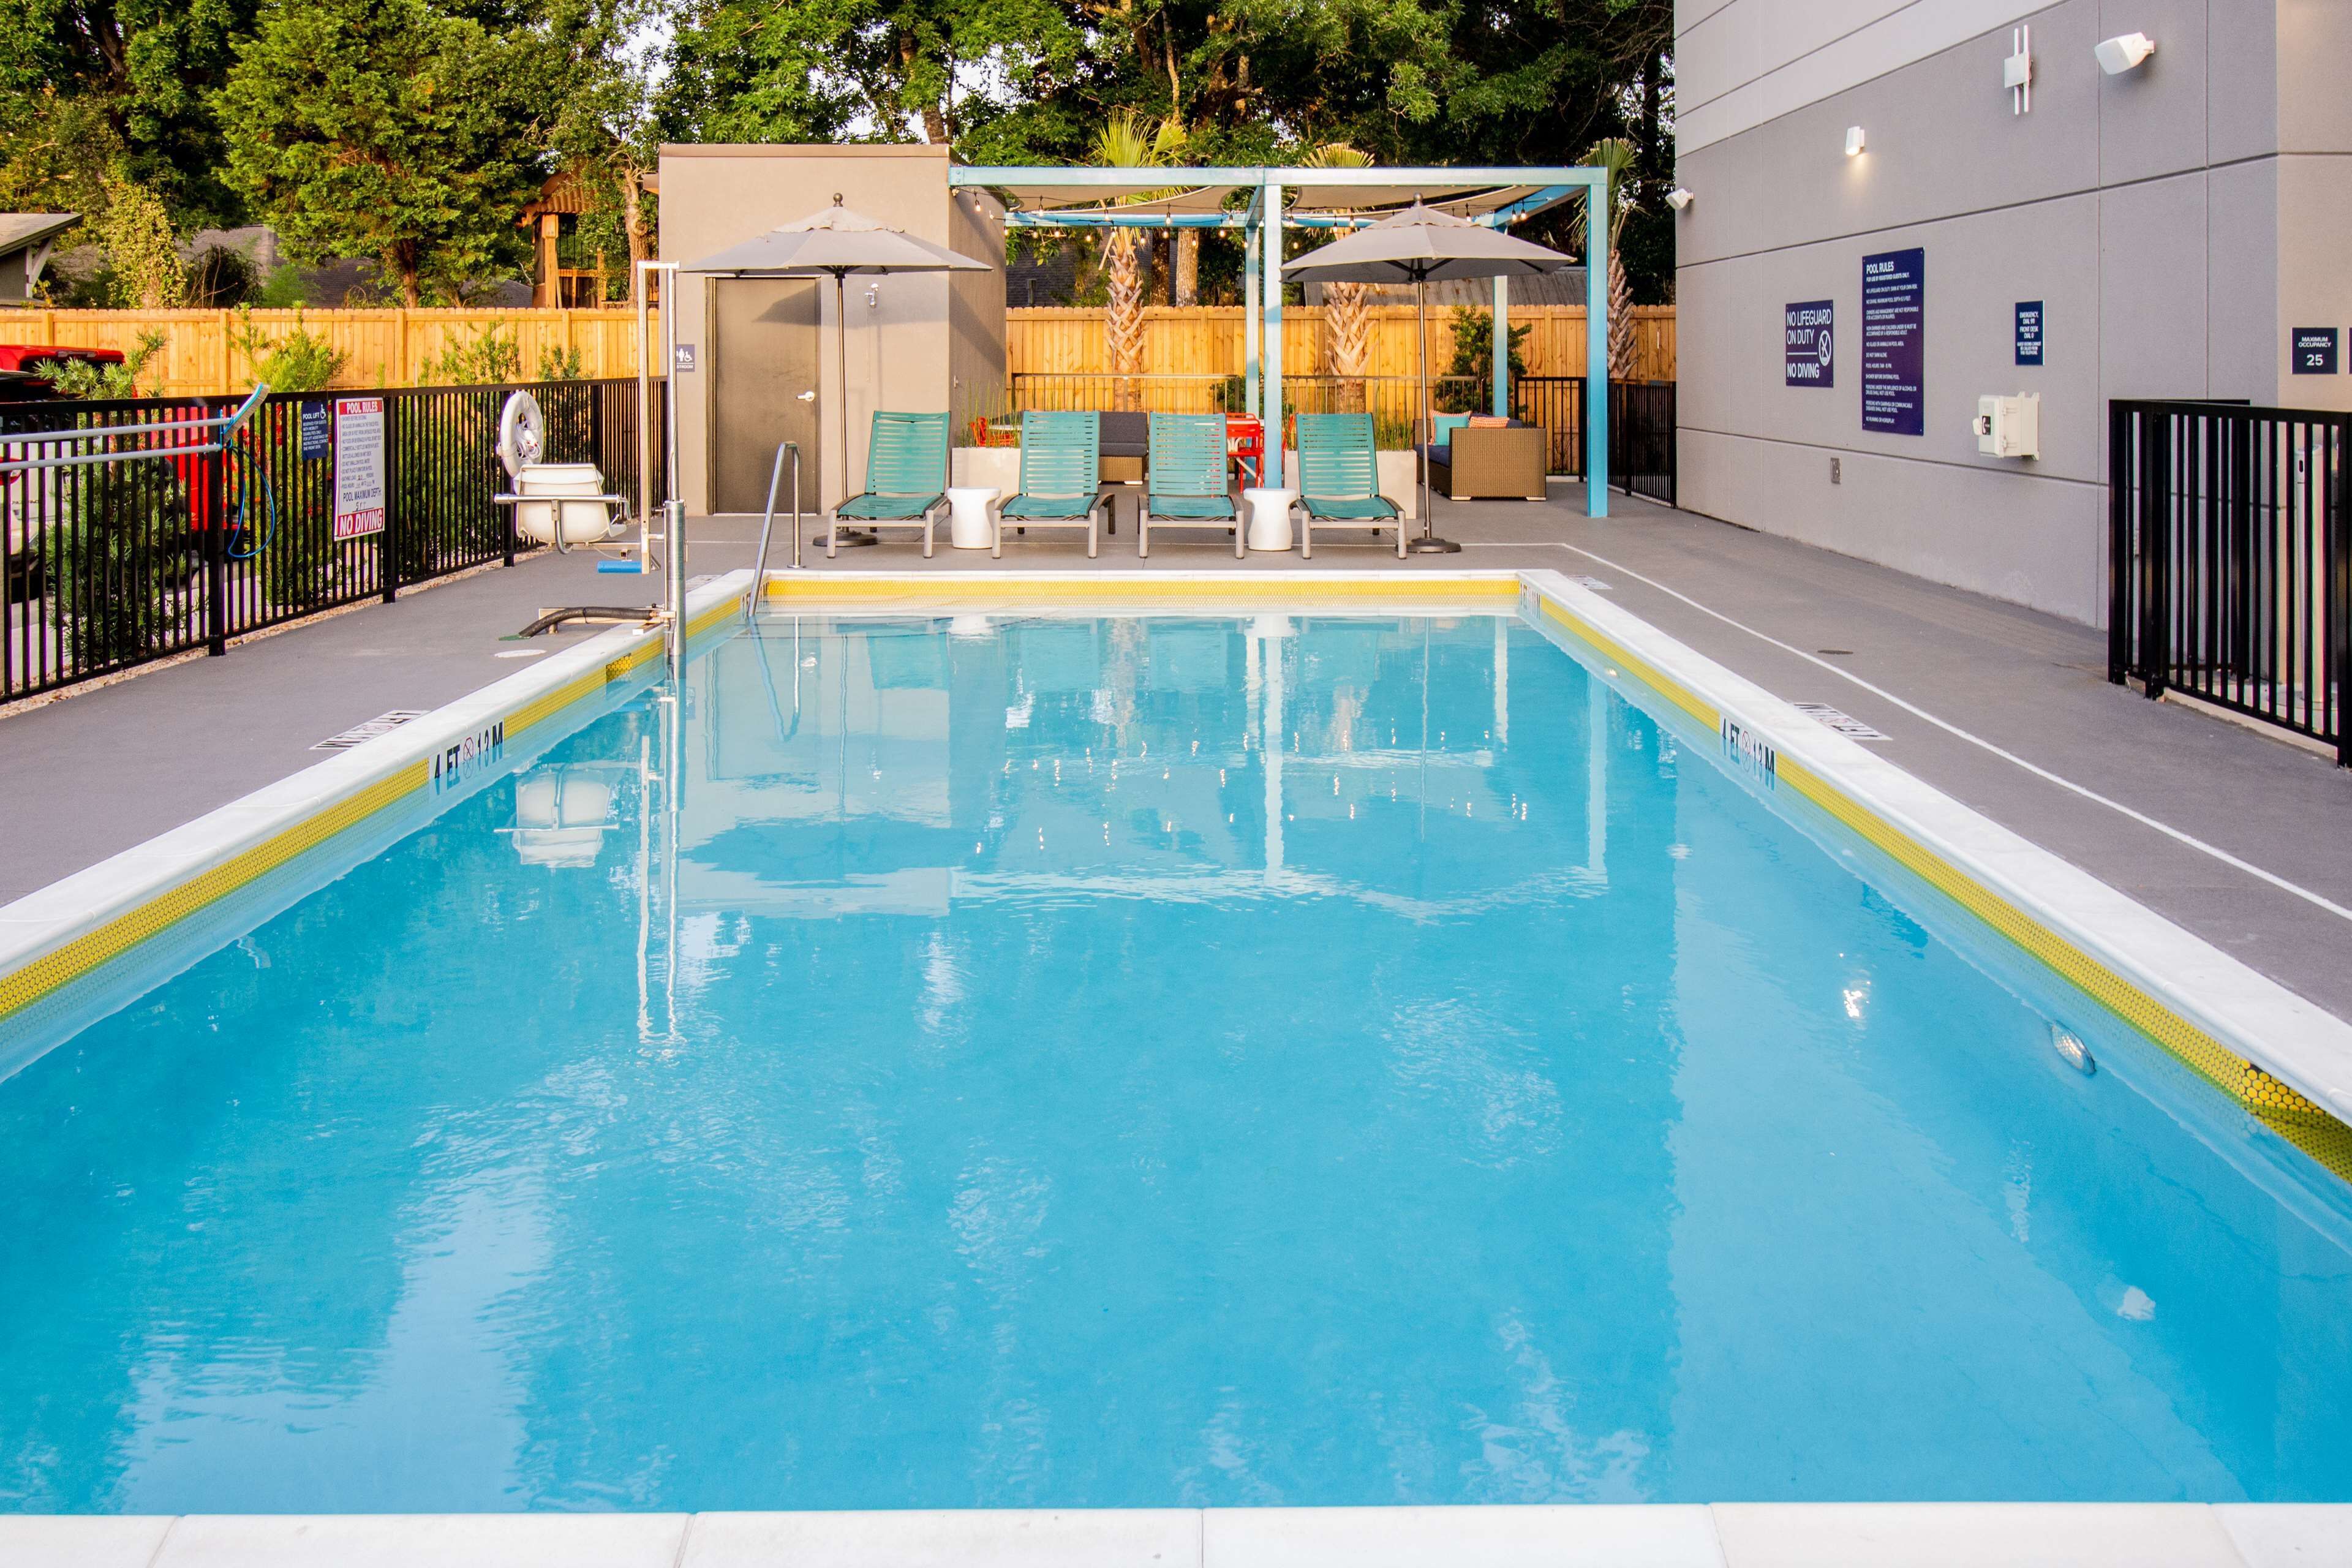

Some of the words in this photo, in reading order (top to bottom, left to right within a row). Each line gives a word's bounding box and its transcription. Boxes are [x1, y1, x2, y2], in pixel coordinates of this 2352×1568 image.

[1866, 263, 1879, 274] POOL
[1879, 261, 1894, 273] RULES
[1787, 312, 1796, 327] NO
[1797, 309, 1831, 326] LIFEGUARD
[1787, 330, 1796, 345] ON
[1797, 329, 1814, 344] DUTY
[2307, 354, 2323, 366] 25
[1787, 363, 1796, 378] NO
[1797, 363, 1819, 379] DIVING
[347, 402, 361, 414] POOL
[363, 401, 377, 412] RULES
[343, 492, 353, 502] POOL
[355, 489, 371, 500] MAXIMUM
[339, 516, 353, 537] NO
[355, 509, 382, 533] DIVING
